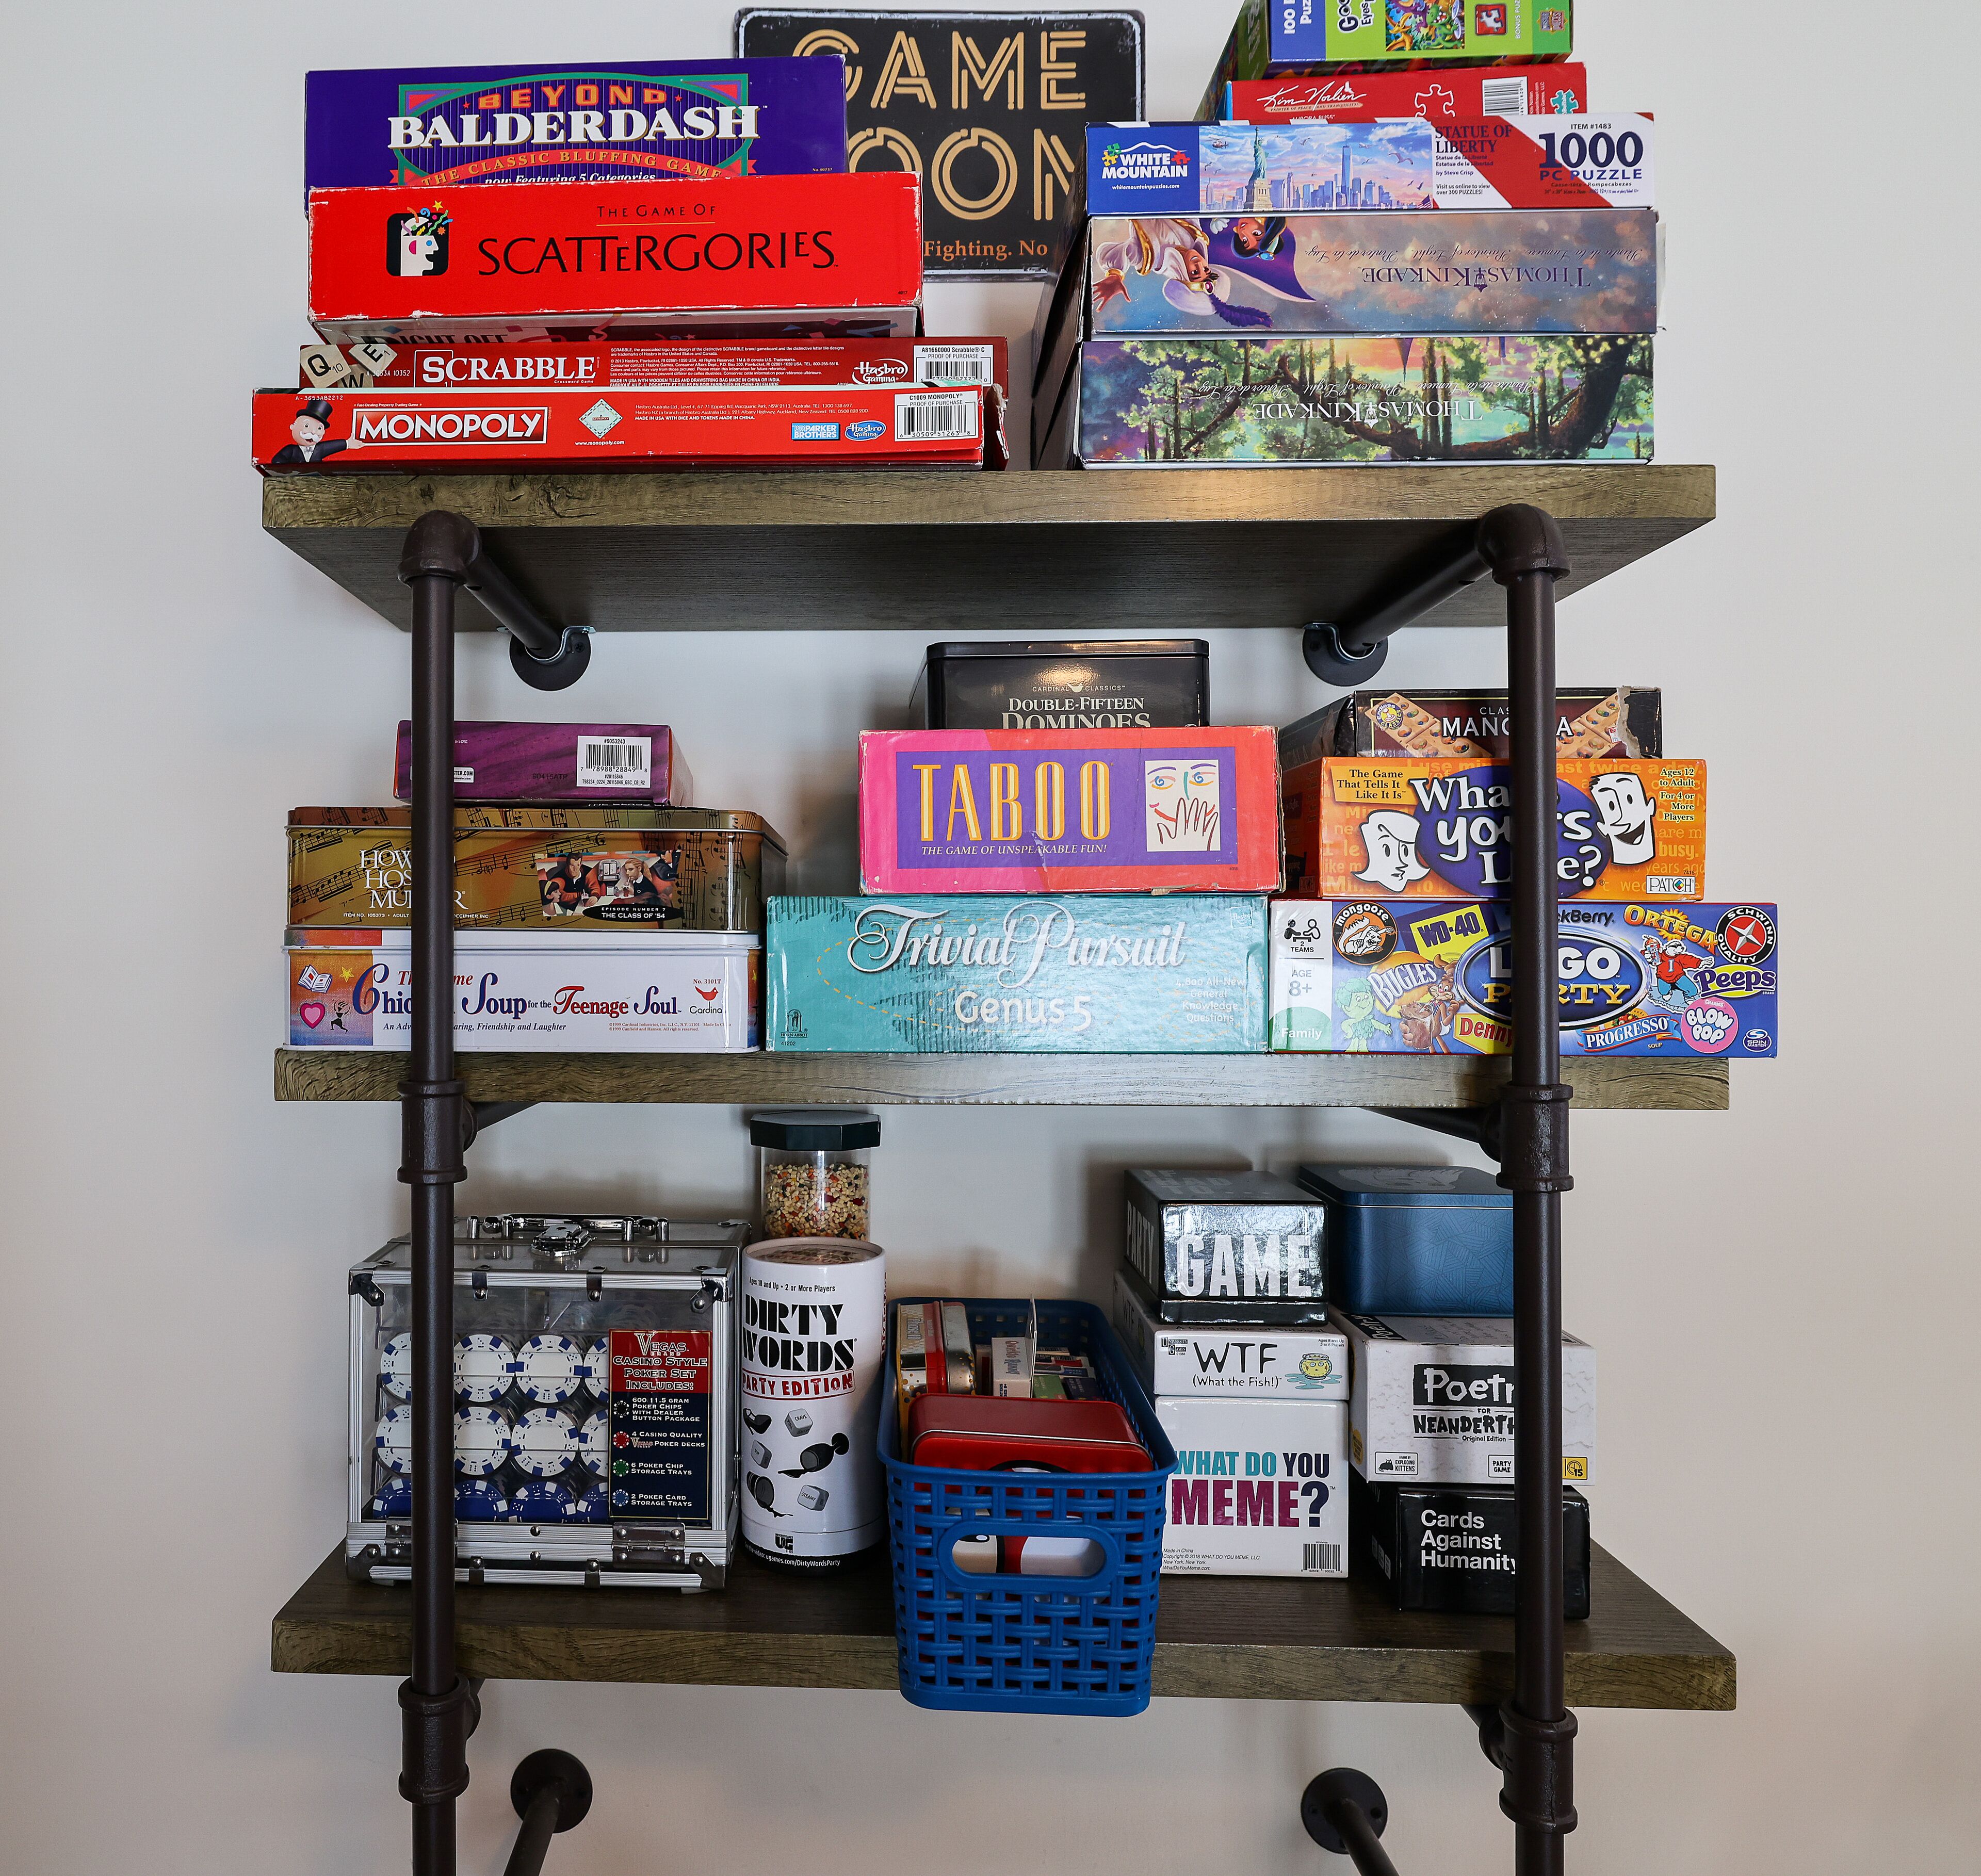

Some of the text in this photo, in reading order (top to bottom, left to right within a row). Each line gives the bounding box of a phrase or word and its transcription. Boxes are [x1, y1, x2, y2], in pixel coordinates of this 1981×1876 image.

[793, 29, 1086, 109] GAME
[478, 84, 667, 109] BEYOND
[1257, 85, 1305, 108] Kim
[387, 106, 760, 150] BALDERDASH
[1435, 124, 1512, 139] STATUE OF
[1436, 139, 1497, 153] LIBERTY
[1538, 132, 1643, 168] 1000
[421, 151, 721, 185] THE CLASSIC BLUFFING GAME
[1120, 153, 1171, 166] WHITE
[1102, 165, 1188, 178] MOUNTAIN
[1540, 169, 1642, 180] PC PUZZLE
[597, 203, 716, 217] THE GAME OF
[478, 231, 835, 276] SCATTERGORIES
[923, 240, 1048, 261] Fighting. No
[1361, 267, 1592, 287] THOMAS KINKADE
[422, 356, 596, 383] SCRABBLE
[854, 362, 904, 377] Hasbro
[862, 373, 896, 384] Gaming
[1252, 401, 1484, 422] THOMAS KINKADE
[360, 413, 541, 439] MONOPOLY
[848, 423, 882, 433] Hasbro
[1008, 697, 1144, 711] DOUBLE-FIFTEEN
[1350, 770, 1403, 778] The Game
[1661, 769, 1682, 777] Ages
[1337, 780, 1360, 788] That
[1363, 780, 1389, 788] Tells
[1356, 790, 1378, 798] Like
[912, 761, 1110, 841] TABOO
[921, 844, 1107, 855] THE GAME OF UNSPEAKABLE FUN!
[1650, 877, 1692, 892] PATCH
[1335, 903, 1389, 926] mongoose
[1417, 911, 1481, 948] WD-40
[1623, 904, 1718, 956] ORTEGA
[1728, 907, 1773, 945] SCHWINN
[847, 901, 1187, 988] Trivial Pursuit
[1718, 933, 1757, 963] QUALITY
[1289, 981, 1312, 996] 8+
[1367, 963, 1438, 1010] BUGLES
[1694, 968, 1776, 991] Peeps
[461, 972, 678, 1019] Soup for the Teenage Soul
[954, 991, 1091, 1032] Genus 5
[1686, 1008, 1733, 1030] BLOW
[477, 1022, 515, 1031] Friendship
[533, 1022, 566, 1031] Laughter
[1280, 1026, 1322, 1041] Family
[1586, 1016, 1669, 1048] PROGRESSO
[1692, 1024, 1725, 1043] POP
[1177, 1234, 1312, 1297] GAME
[745, 1293, 844, 1335] DIRTY
[743, 1326, 854, 1372] WORDS
[1193, 1342, 1278, 1374] WTF
[613, 1356, 707, 1366] CASINO STYLE
[624, 1368, 696, 1378] POKER SET
[1193, 1374, 1279, 1389] (What the Fish!)
[626, 1380, 694, 1390] INCLUDES:
[743, 1373, 853, 1396] PARTY EDITION
[1175, 1451, 1329, 1478] WHAT DO YOU
[1172, 1479, 1330, 1528] MEME?
[1421, 1509, 1485, 1528] Cards
[1421, 1530, 1502, 1551] Against
[766, 1554, 840, 1568] ugames.com/DirtyWordsParty
[1421, 1551, 1516, 1574] Humanity
